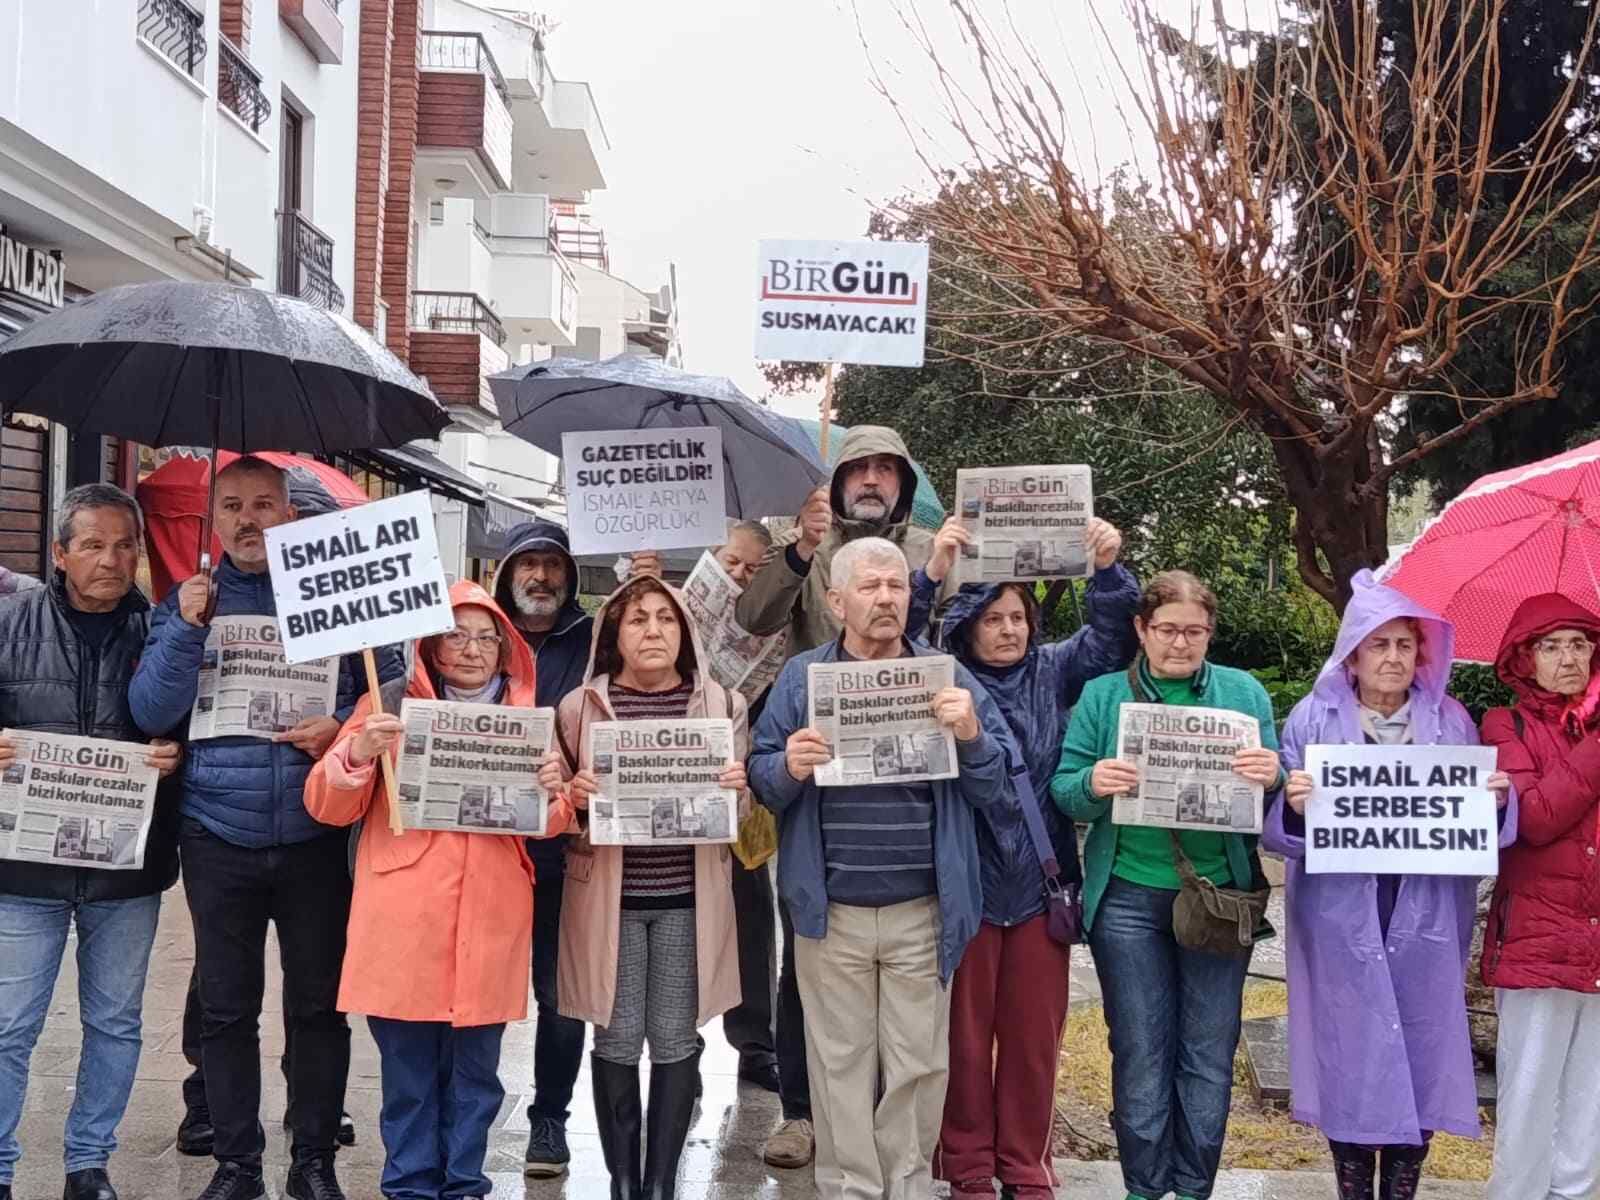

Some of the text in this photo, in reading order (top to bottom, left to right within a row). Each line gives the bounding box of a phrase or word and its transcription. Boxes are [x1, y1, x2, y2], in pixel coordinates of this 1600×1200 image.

[761, 311, 916, 334] SUSMAYACAK!
[582, 438, 706, 463] GAZETECİLİK
[577, 462, 712, 489] SUÇ DEĞİLDİR!
[281, 516, 420, 571] İSMAİL ARI
[299, 553, 413, 601] SERBEST
[287, 581, 442, 638] BIRAKILSIN!
[221, 665, 329, 683] bizi korkutamaz
[678, 755, 728, 767] cezalar
[94, 776, 147, 793] cezalar
[1322, 761, 1477, 788] İSMAİL ARI
[28, 784, 145, 810] bizi korkutamaz
[1334, 796, 1464, 819] SERBEST
[1313, 827, 1488, 851] BIRAKILSIN!
